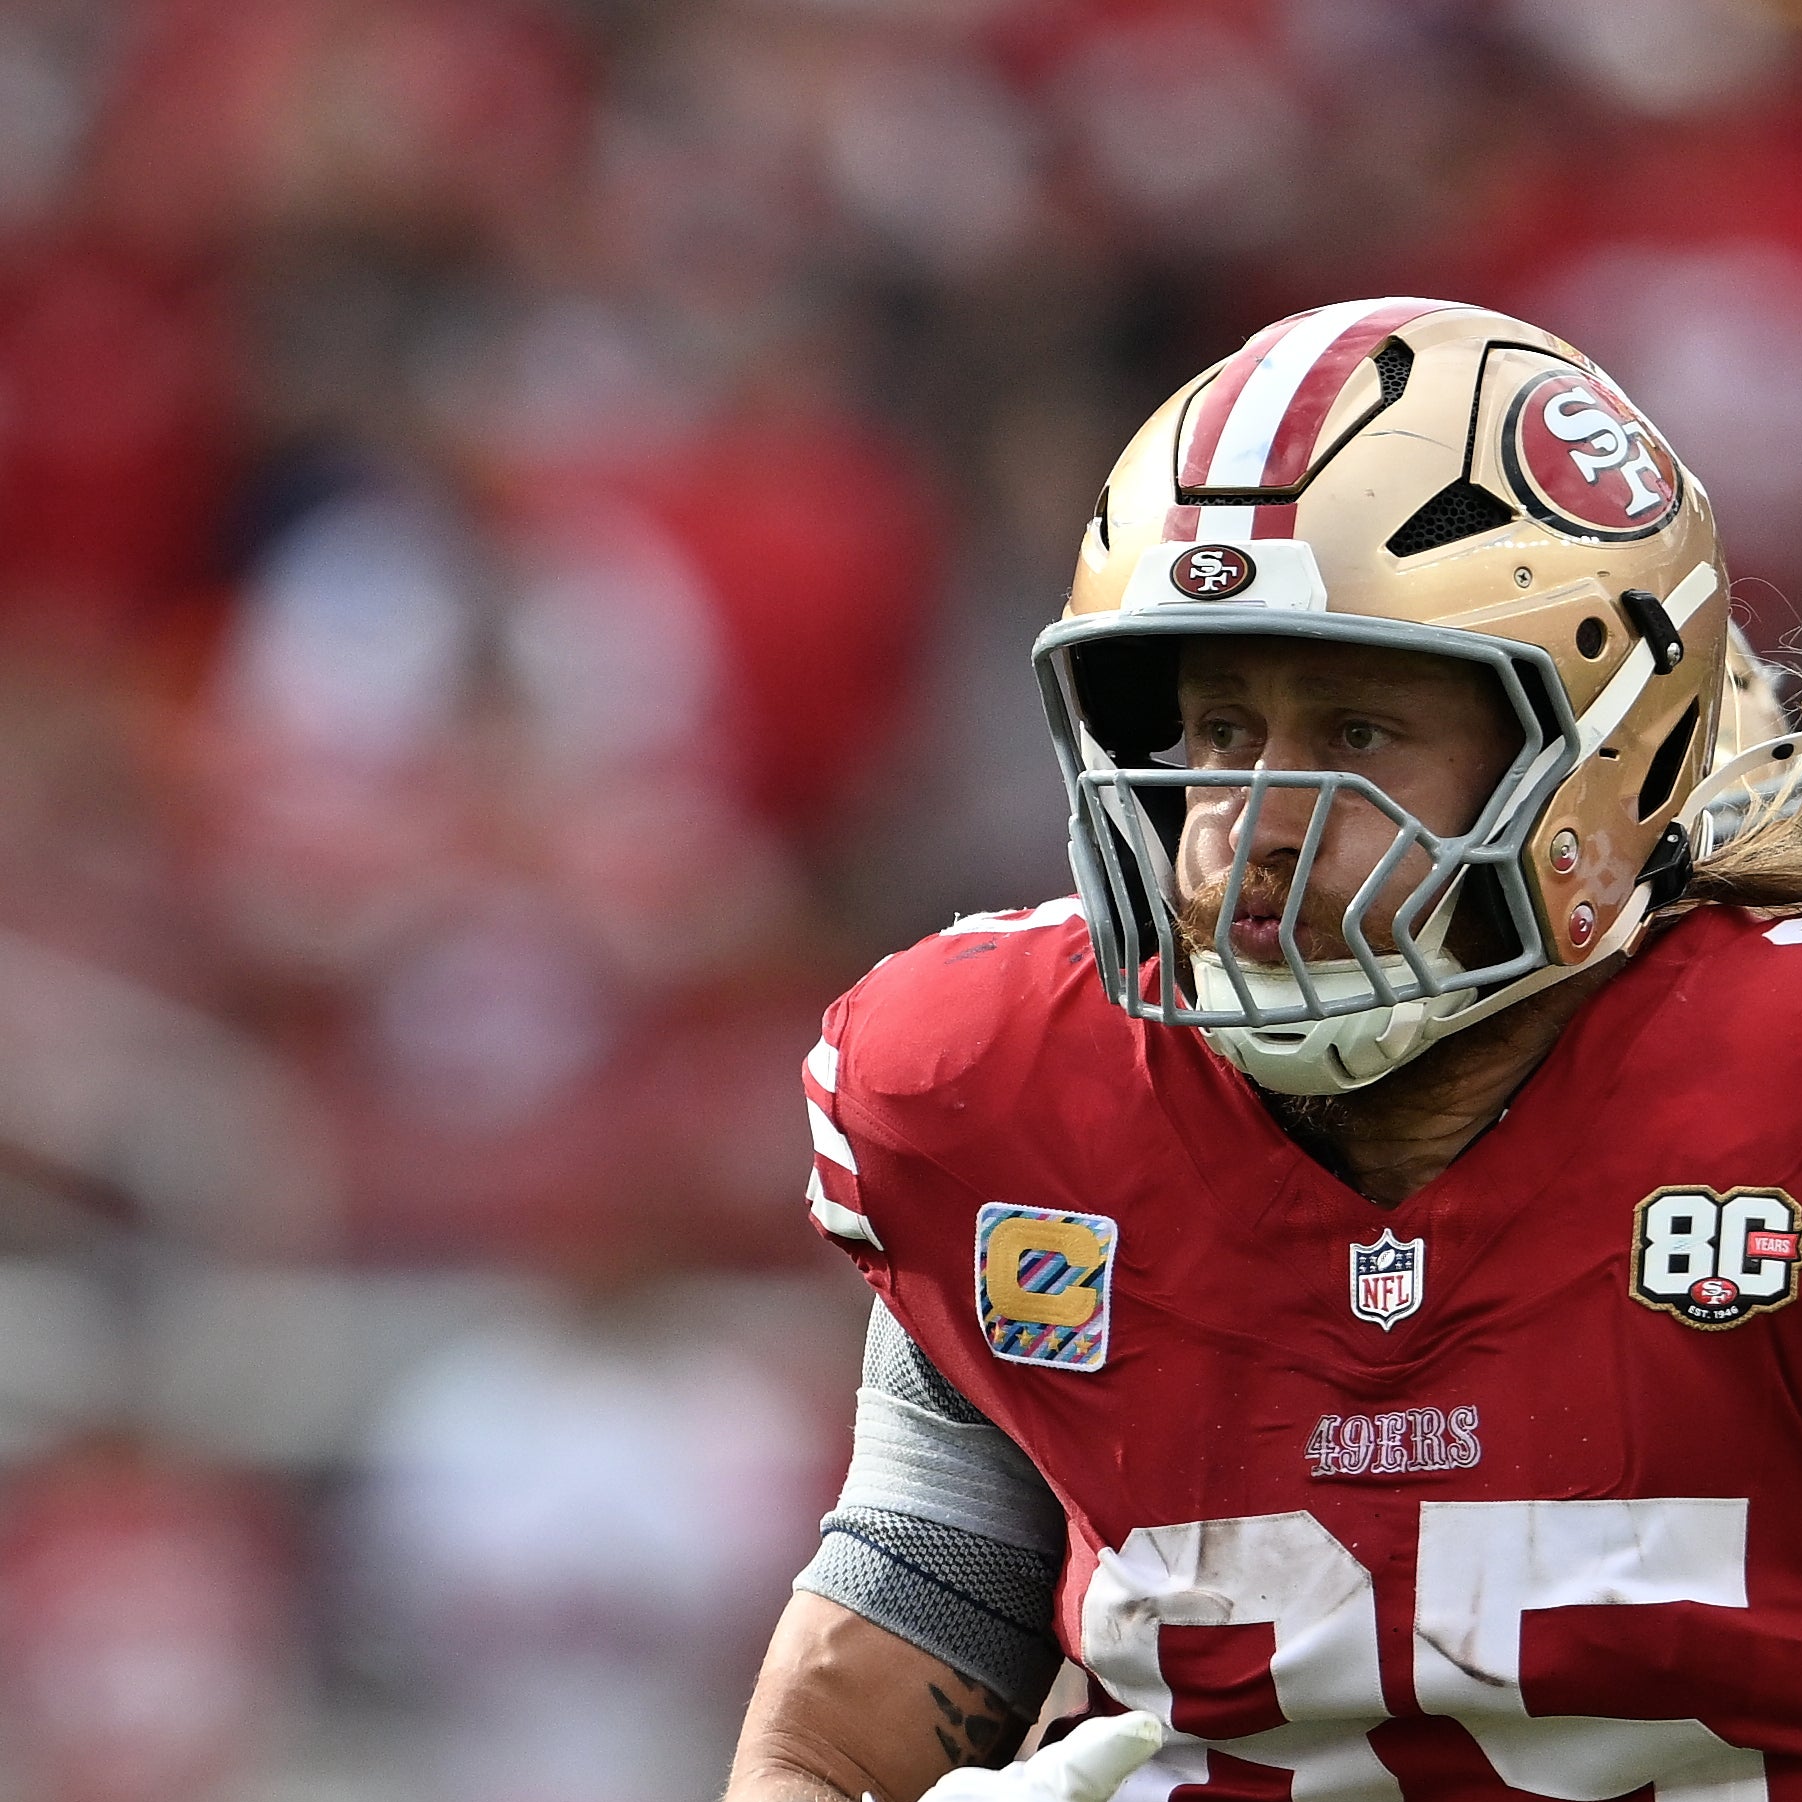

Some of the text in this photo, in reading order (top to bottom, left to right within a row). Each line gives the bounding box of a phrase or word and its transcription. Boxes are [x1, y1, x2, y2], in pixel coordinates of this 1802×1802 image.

[1754, 1235, 1791, 1254] YEARS
[986, 1216, 1101, 1328] C
[1361, 1274, 1411, 1313] NFL
[1687, 1305, 1739, 1319] EST. 1946
[1303, 1405, 1482, 1477] 49ERS
